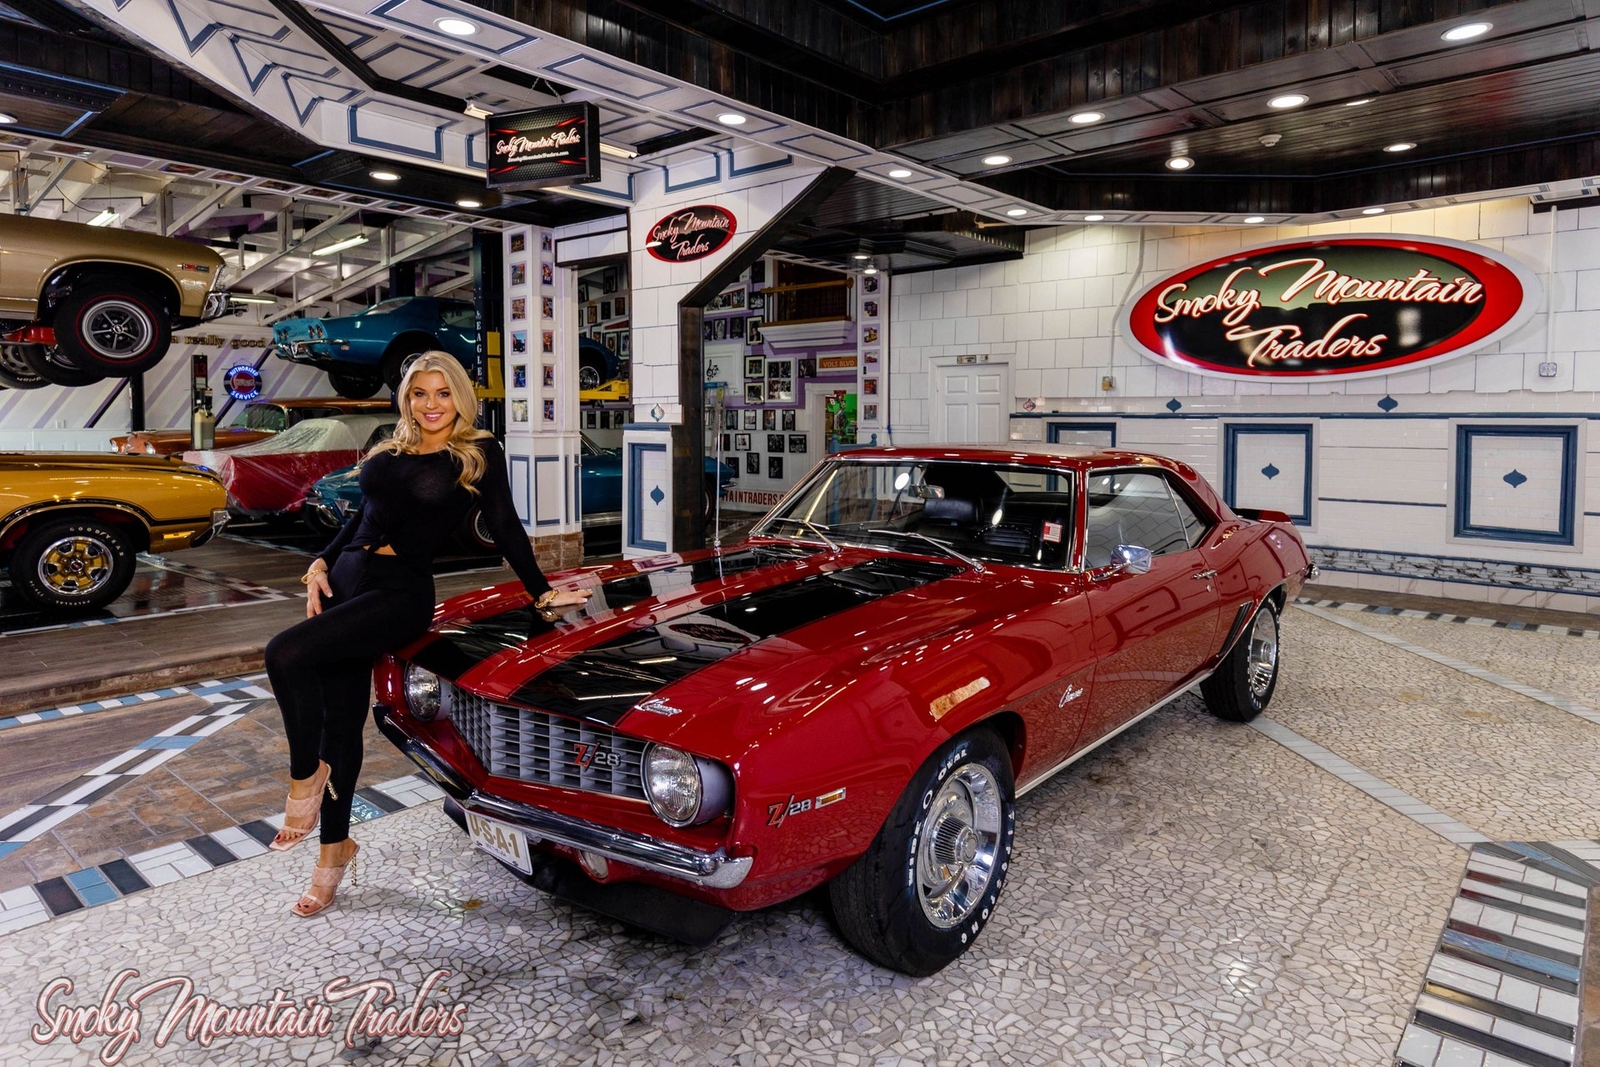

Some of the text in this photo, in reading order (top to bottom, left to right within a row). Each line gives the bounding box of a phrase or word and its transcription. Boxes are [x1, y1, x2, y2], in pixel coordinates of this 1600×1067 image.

[652, 212, 729, 243] Smoky Mountain
[671, 234, 710, 260] Traders
[1154, 258, 1485, 326] Smoky Mountain
[184, 335, 225, 348] really
[230, 338, 266, 349] good
[1225, 313, 1387, 368] Traders
[229, 365, 259, 376] AUTHORIZED
[231, 390, 259, 400] SERVICE
[69, 527, 124, 556] GOODYEAR
[573, 742, 620, 772] Z/28
[938, 749, 968, 781] OVAL
[767, 794, 811, 828] Z/28
